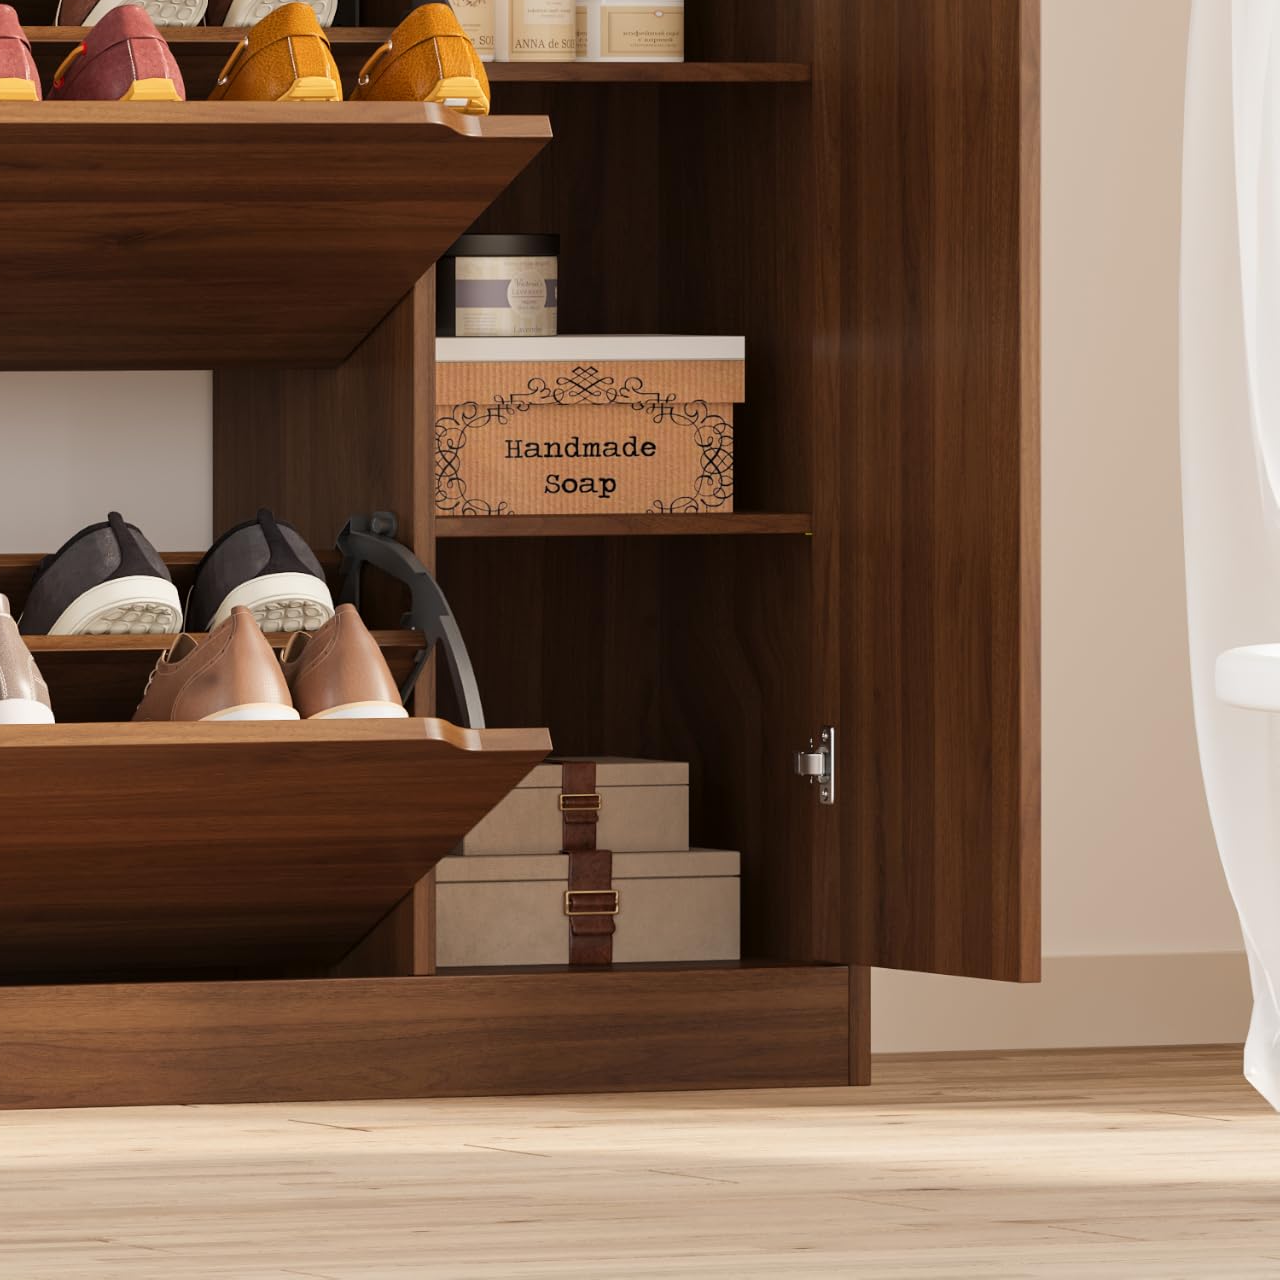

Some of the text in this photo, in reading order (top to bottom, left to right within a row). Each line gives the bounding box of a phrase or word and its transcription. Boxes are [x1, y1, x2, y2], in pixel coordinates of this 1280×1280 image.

[515, 38, 545, 49] ANNA
[548, 38, 559, 49] de
[505, 436, 657, 459] Handmade
[544, 474, 617, 498] Soap
